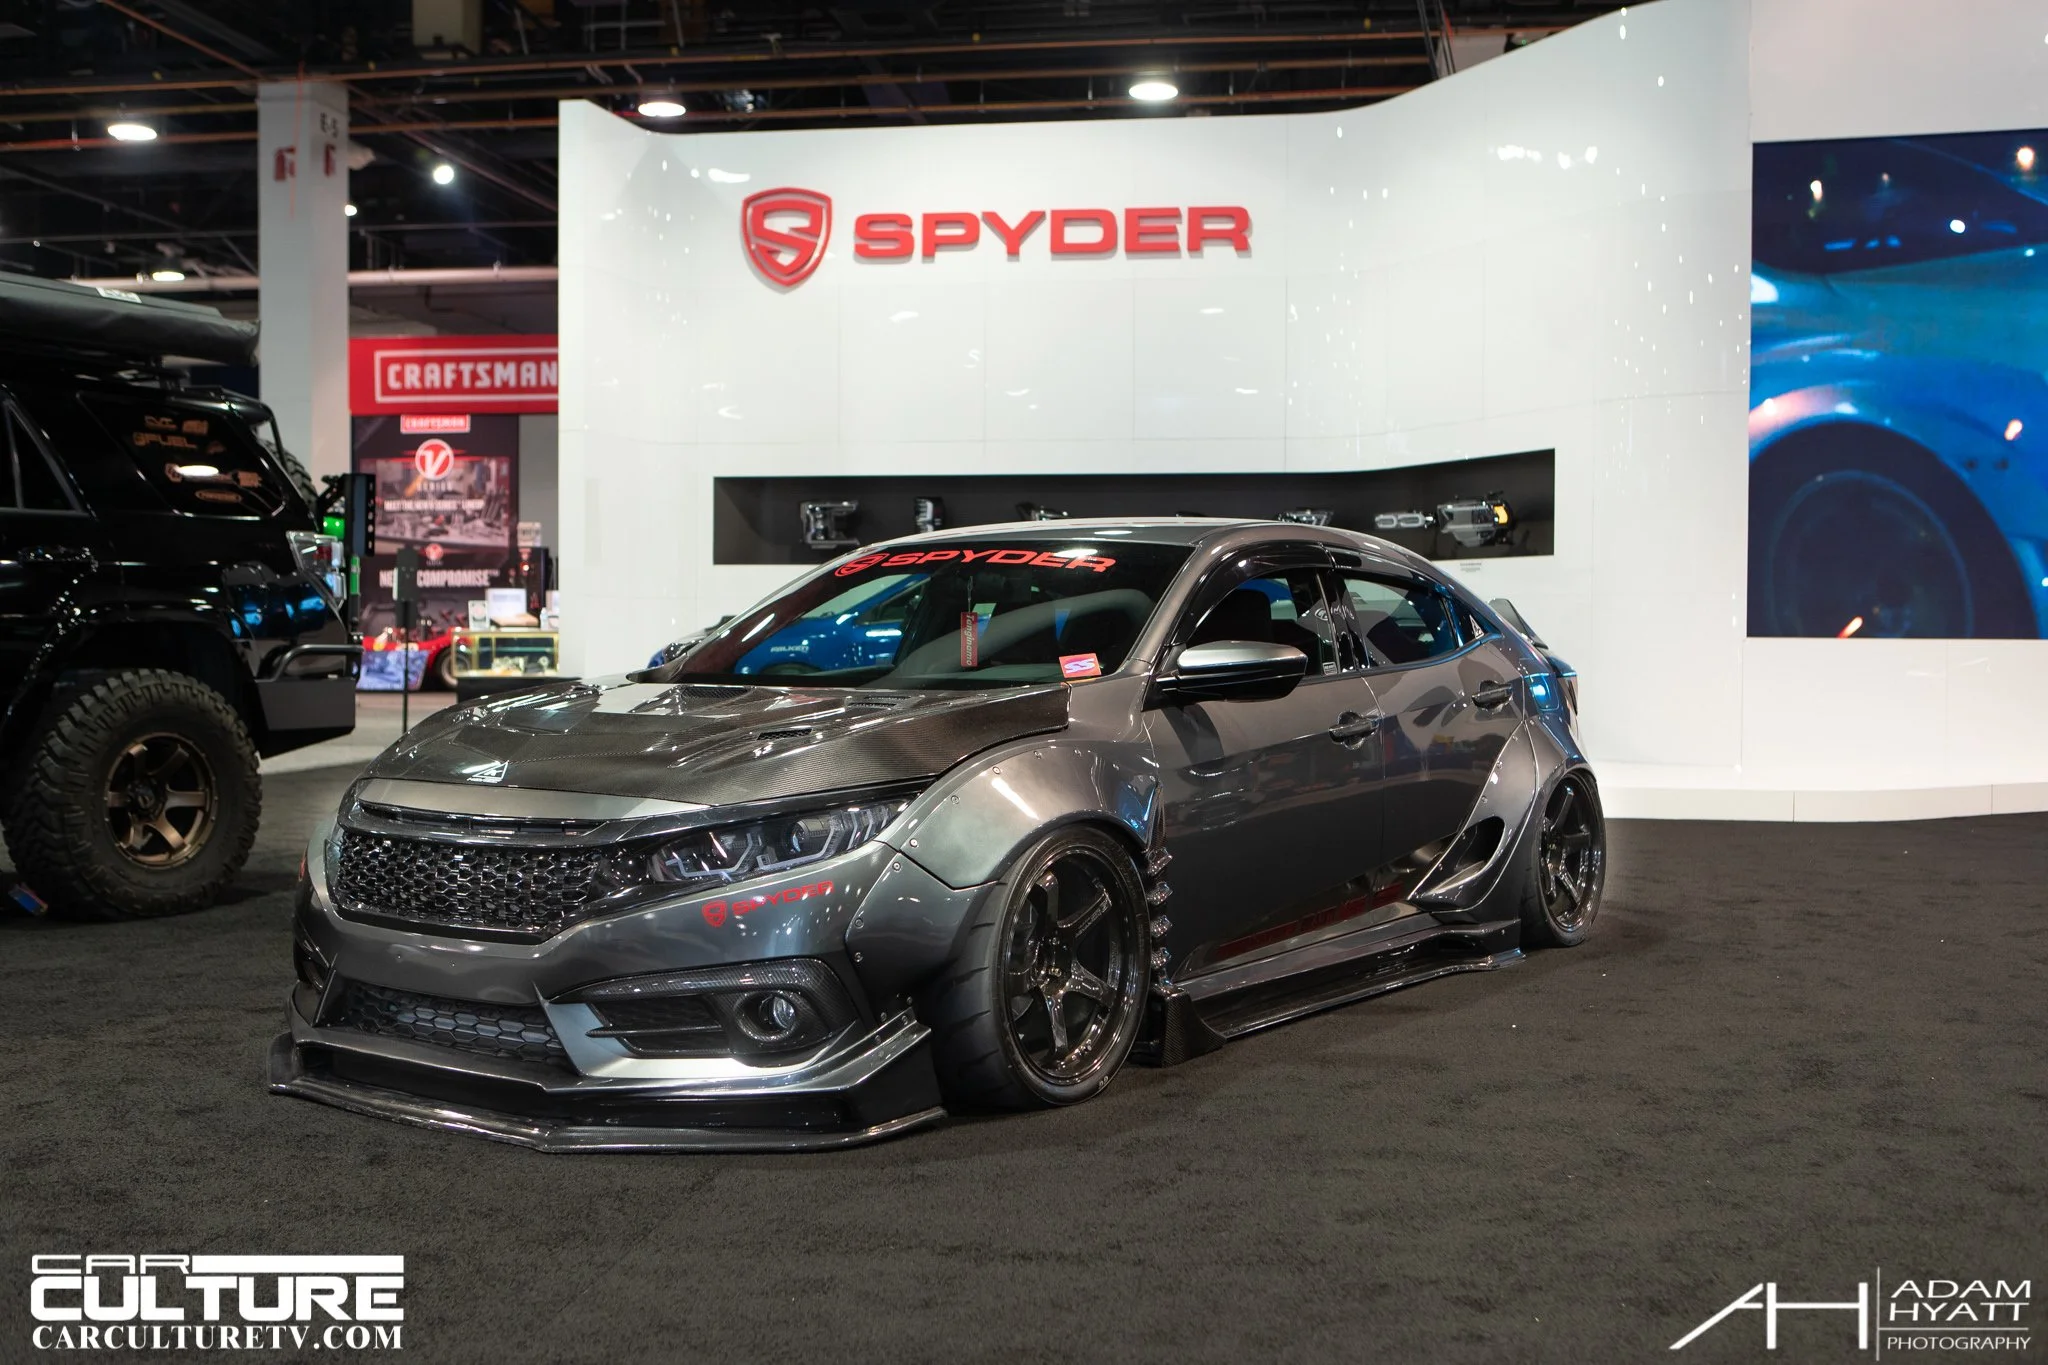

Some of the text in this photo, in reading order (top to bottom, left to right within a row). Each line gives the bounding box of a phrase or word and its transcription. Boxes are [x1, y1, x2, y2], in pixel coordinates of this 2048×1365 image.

[854, 206, 1252, 258] SPYDER
[387, 360, 558, 389] CRAFTSMAN
[881, 549, 1117, 573] SPYDER
[731, 880, 835, 915] SPYDER
